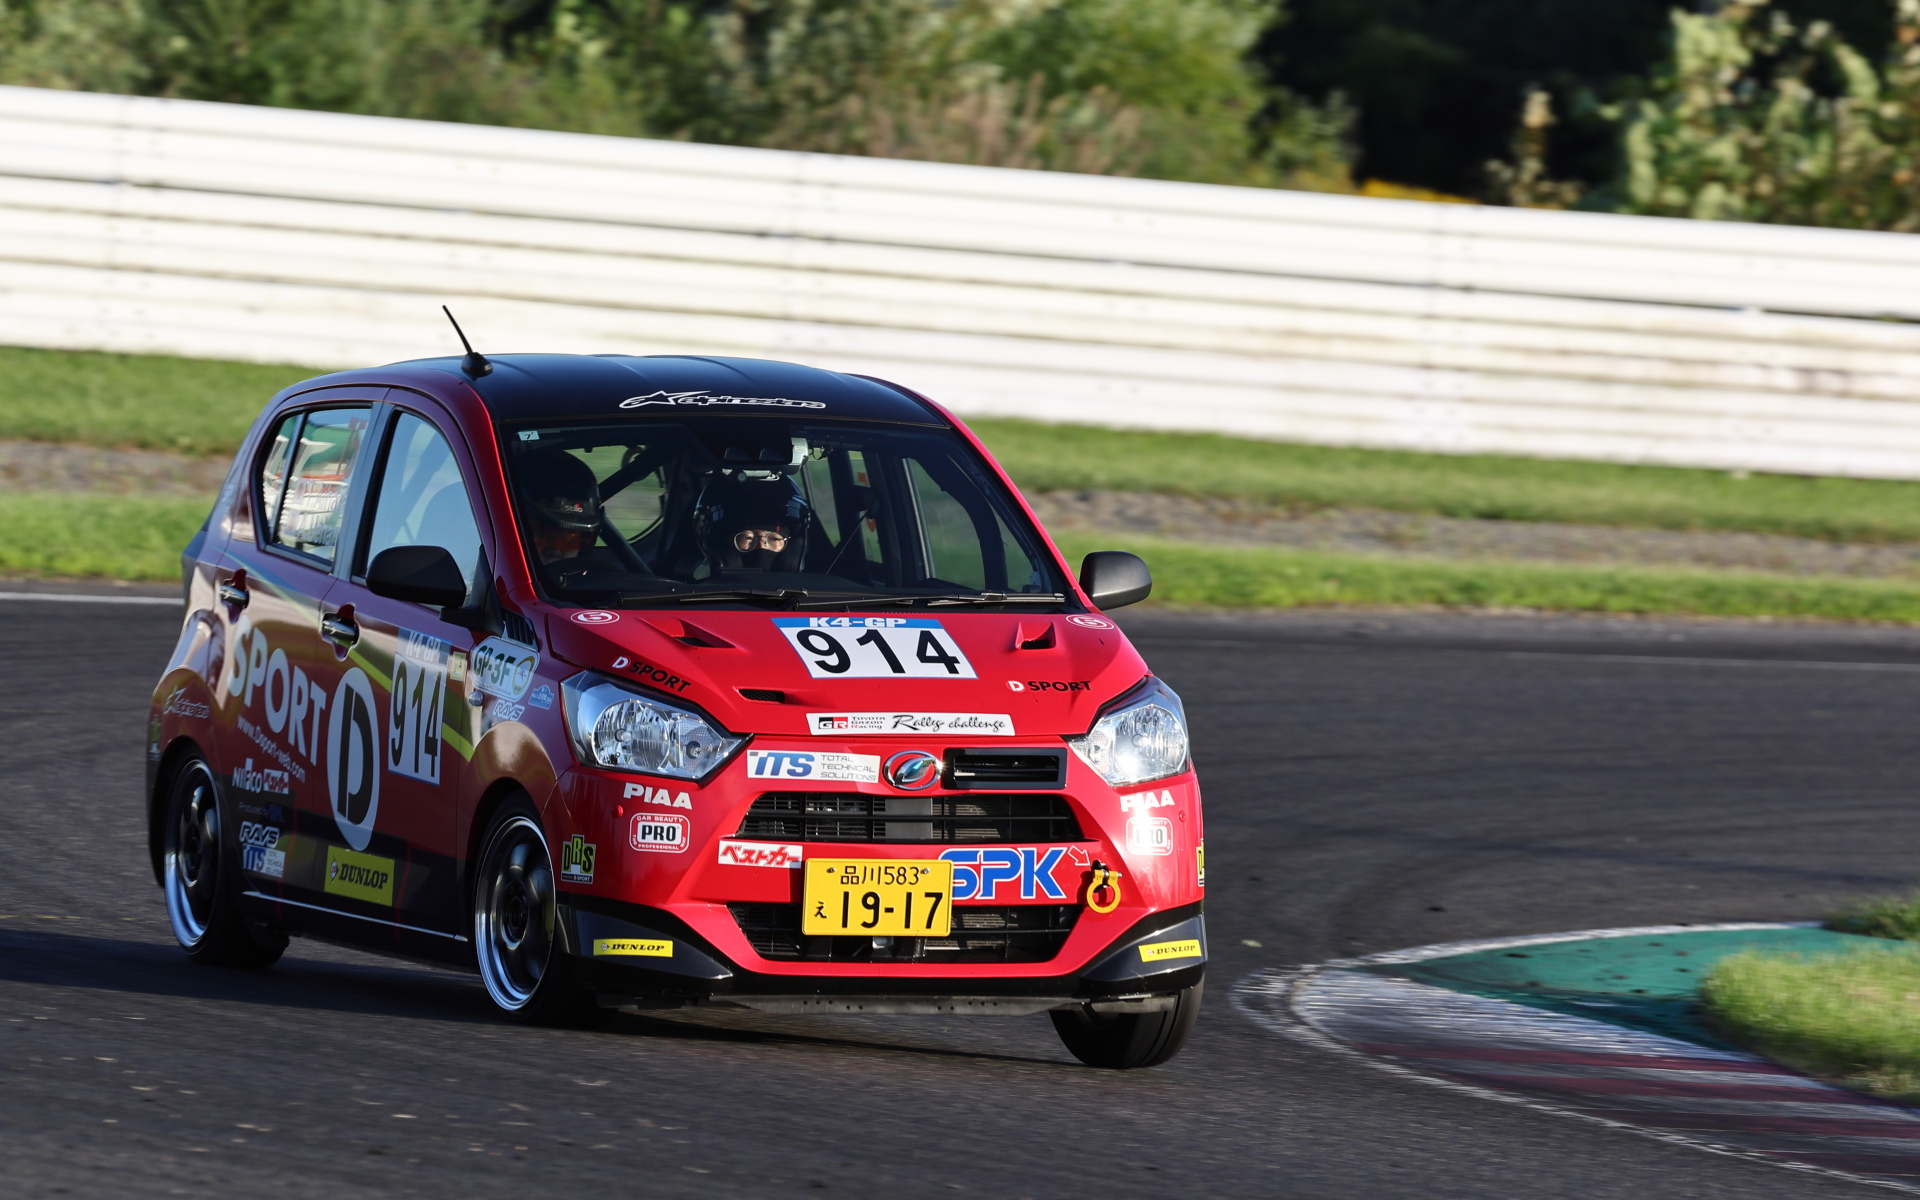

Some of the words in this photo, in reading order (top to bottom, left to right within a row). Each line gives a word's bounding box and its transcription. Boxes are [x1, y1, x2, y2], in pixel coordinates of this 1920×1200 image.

[809, 617, 907, 628] K4-GP
[406, 630, 442, 663] K4-GP
[797, 629, 961, 675] 914
[473, 645, 517, 687] GP-3F
[628, 661, 692, 692] SPORT
[226, 614, 327, 767] SPORT
[1027, 680, 1092, 692] SPORT
[391, 661, 442, 778] 914
[493, 700, 526, 721] RAYS
[819, 716, 849, 729] GR
[892, 714, 944, 732] Rally
[948, 717, 1006, 733] challenge
[336, 682, 374, 826] D
[821, 754, 854, 763] TOTAL
[820, 772, 877, 782] SOLUTIONS
[821, 763, 876, 773] TECHNICAL
[623, 782, 693, 810] PIAA
[654, 815, 684, 824] BEAUTY
[239, 820, 280, 849] RAYS
[641, 824, 677, 842] PRO
[562, 836, 595, 873] DRS
[721, 845, 800, 866] ベストカー
[339, 862, 389, 891] DUNLOP
[938, 847, 1068, 900] SPK
[814, 900, 828, 919] え
[841, 890, 944, 930] 19-17
[611, 943, 665, 952] DUNLOP
[1156, 944, 1197, 955] DUNLOP
